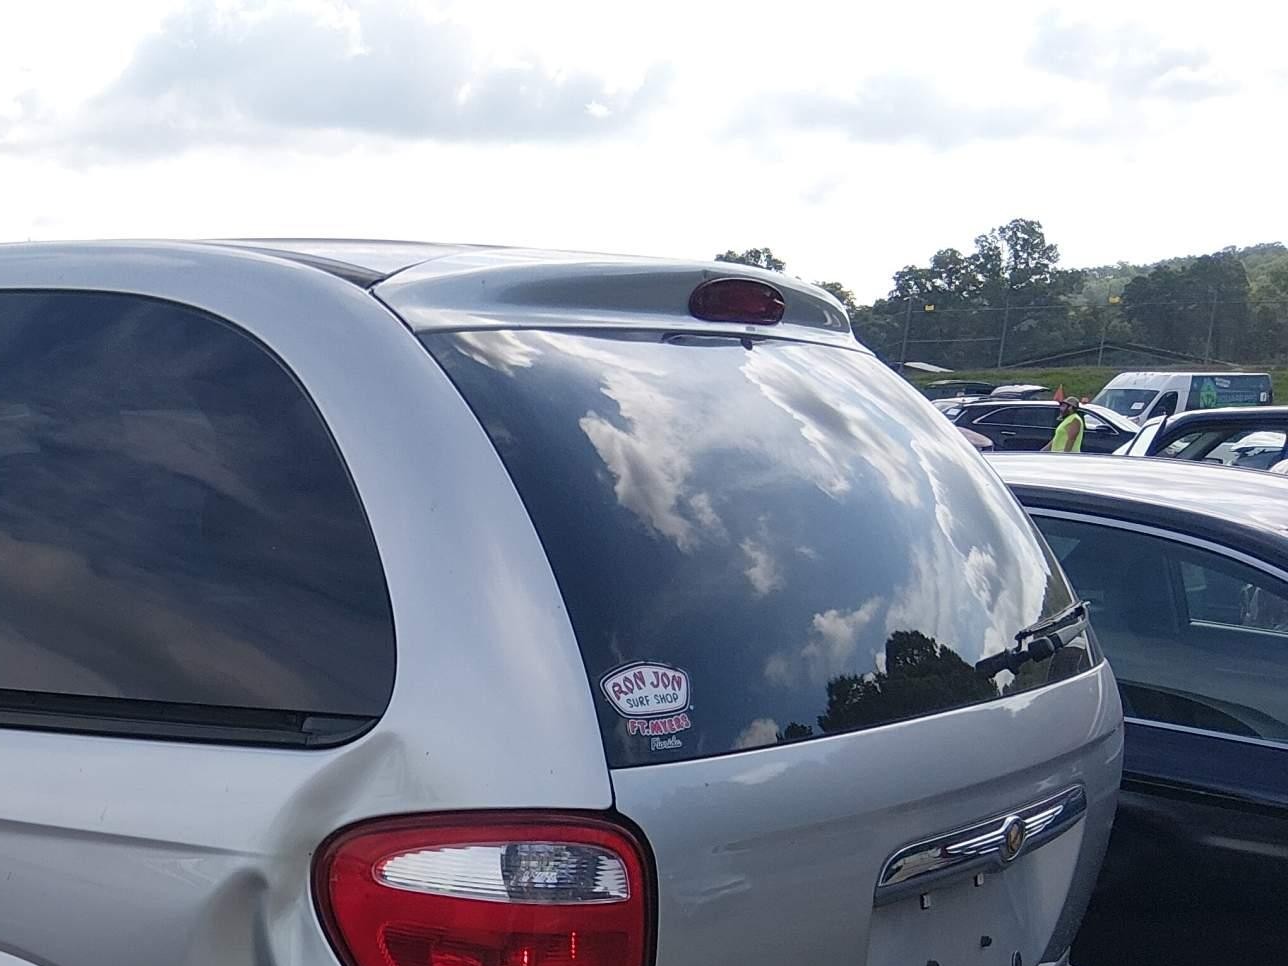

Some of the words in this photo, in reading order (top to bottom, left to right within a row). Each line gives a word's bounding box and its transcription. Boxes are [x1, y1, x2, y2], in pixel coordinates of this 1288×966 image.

[611, 670, 646, 701] RON
[650, 671, 682, 691] JON
[626, 695, 651, 709] SURF
[655, 693, 679, 705] SHOP
